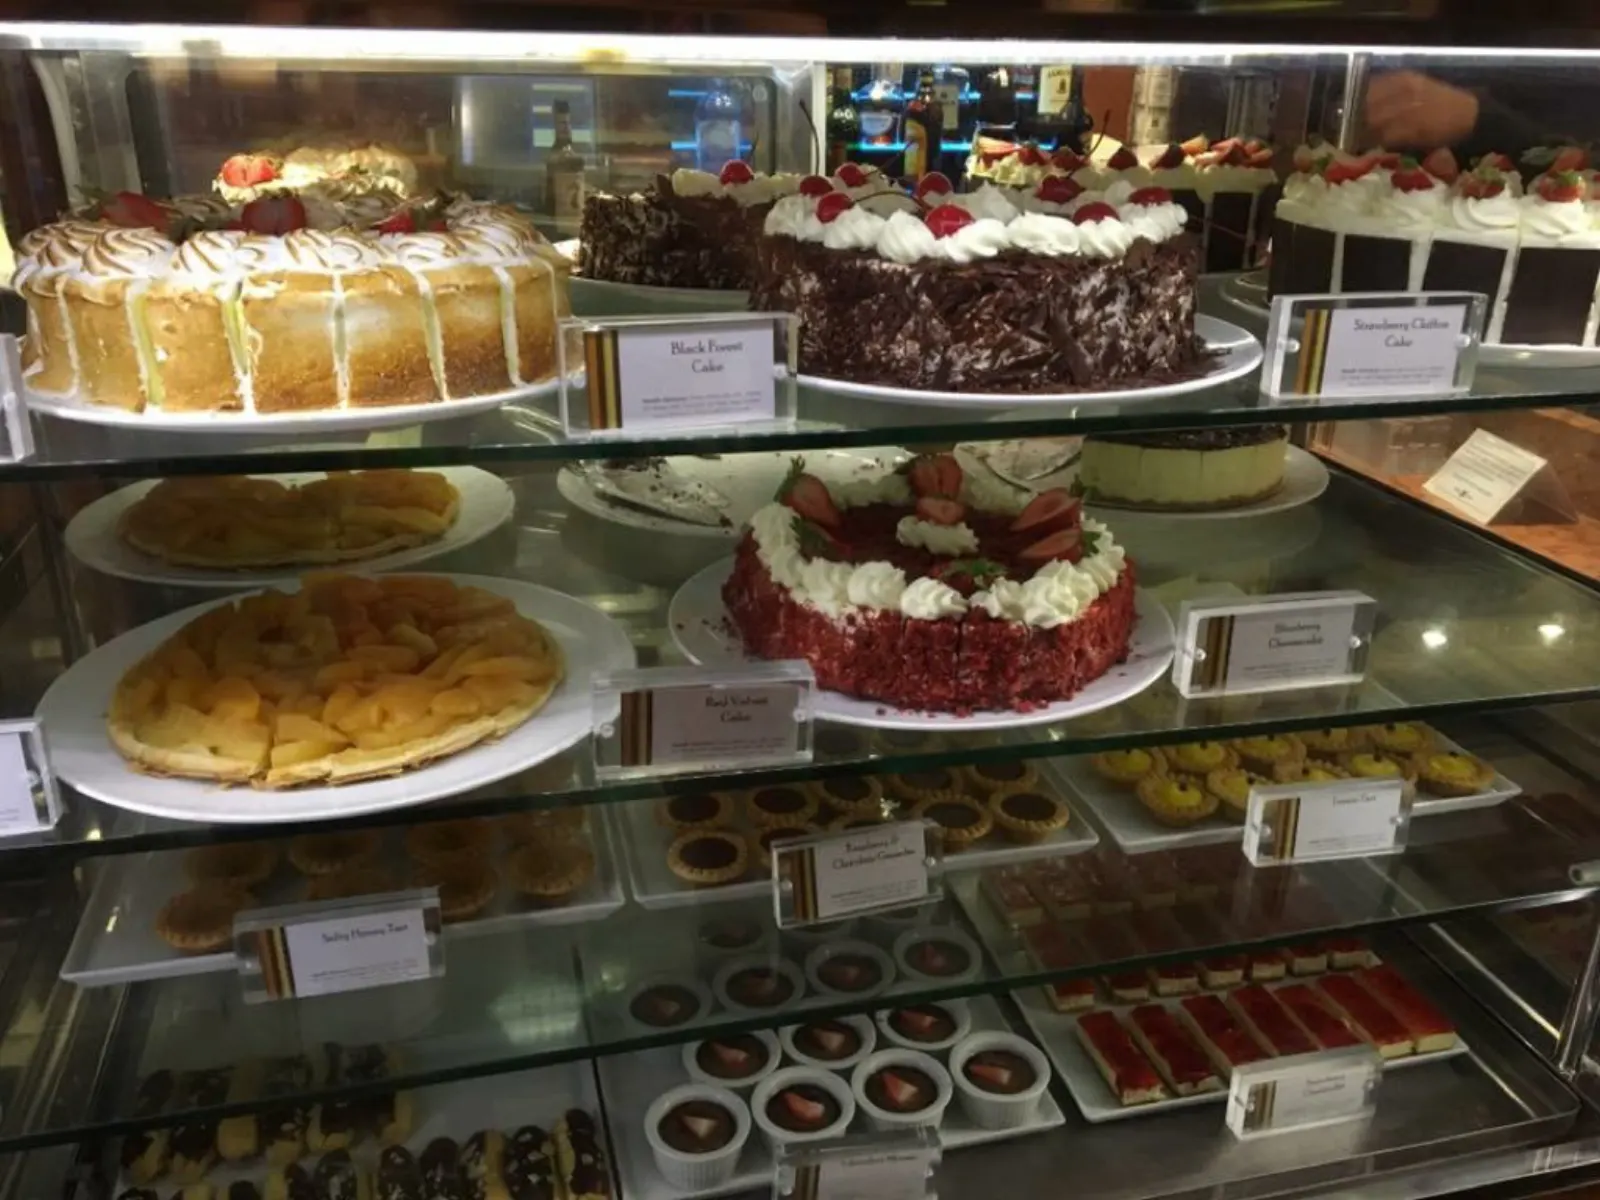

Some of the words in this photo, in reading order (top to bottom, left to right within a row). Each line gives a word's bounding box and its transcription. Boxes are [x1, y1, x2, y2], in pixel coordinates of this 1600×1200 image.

[1353, 318, 1409, 332] Strawberry
[671, 340, 705, 355] Black
[708, 338, 743, 353] Forest
[1384, 335, 1413, 347] Cake
[691, 359, 724, 373] Cake
[705, 697, 728, 707] Red
[720, 710, 752, 722] Cake
